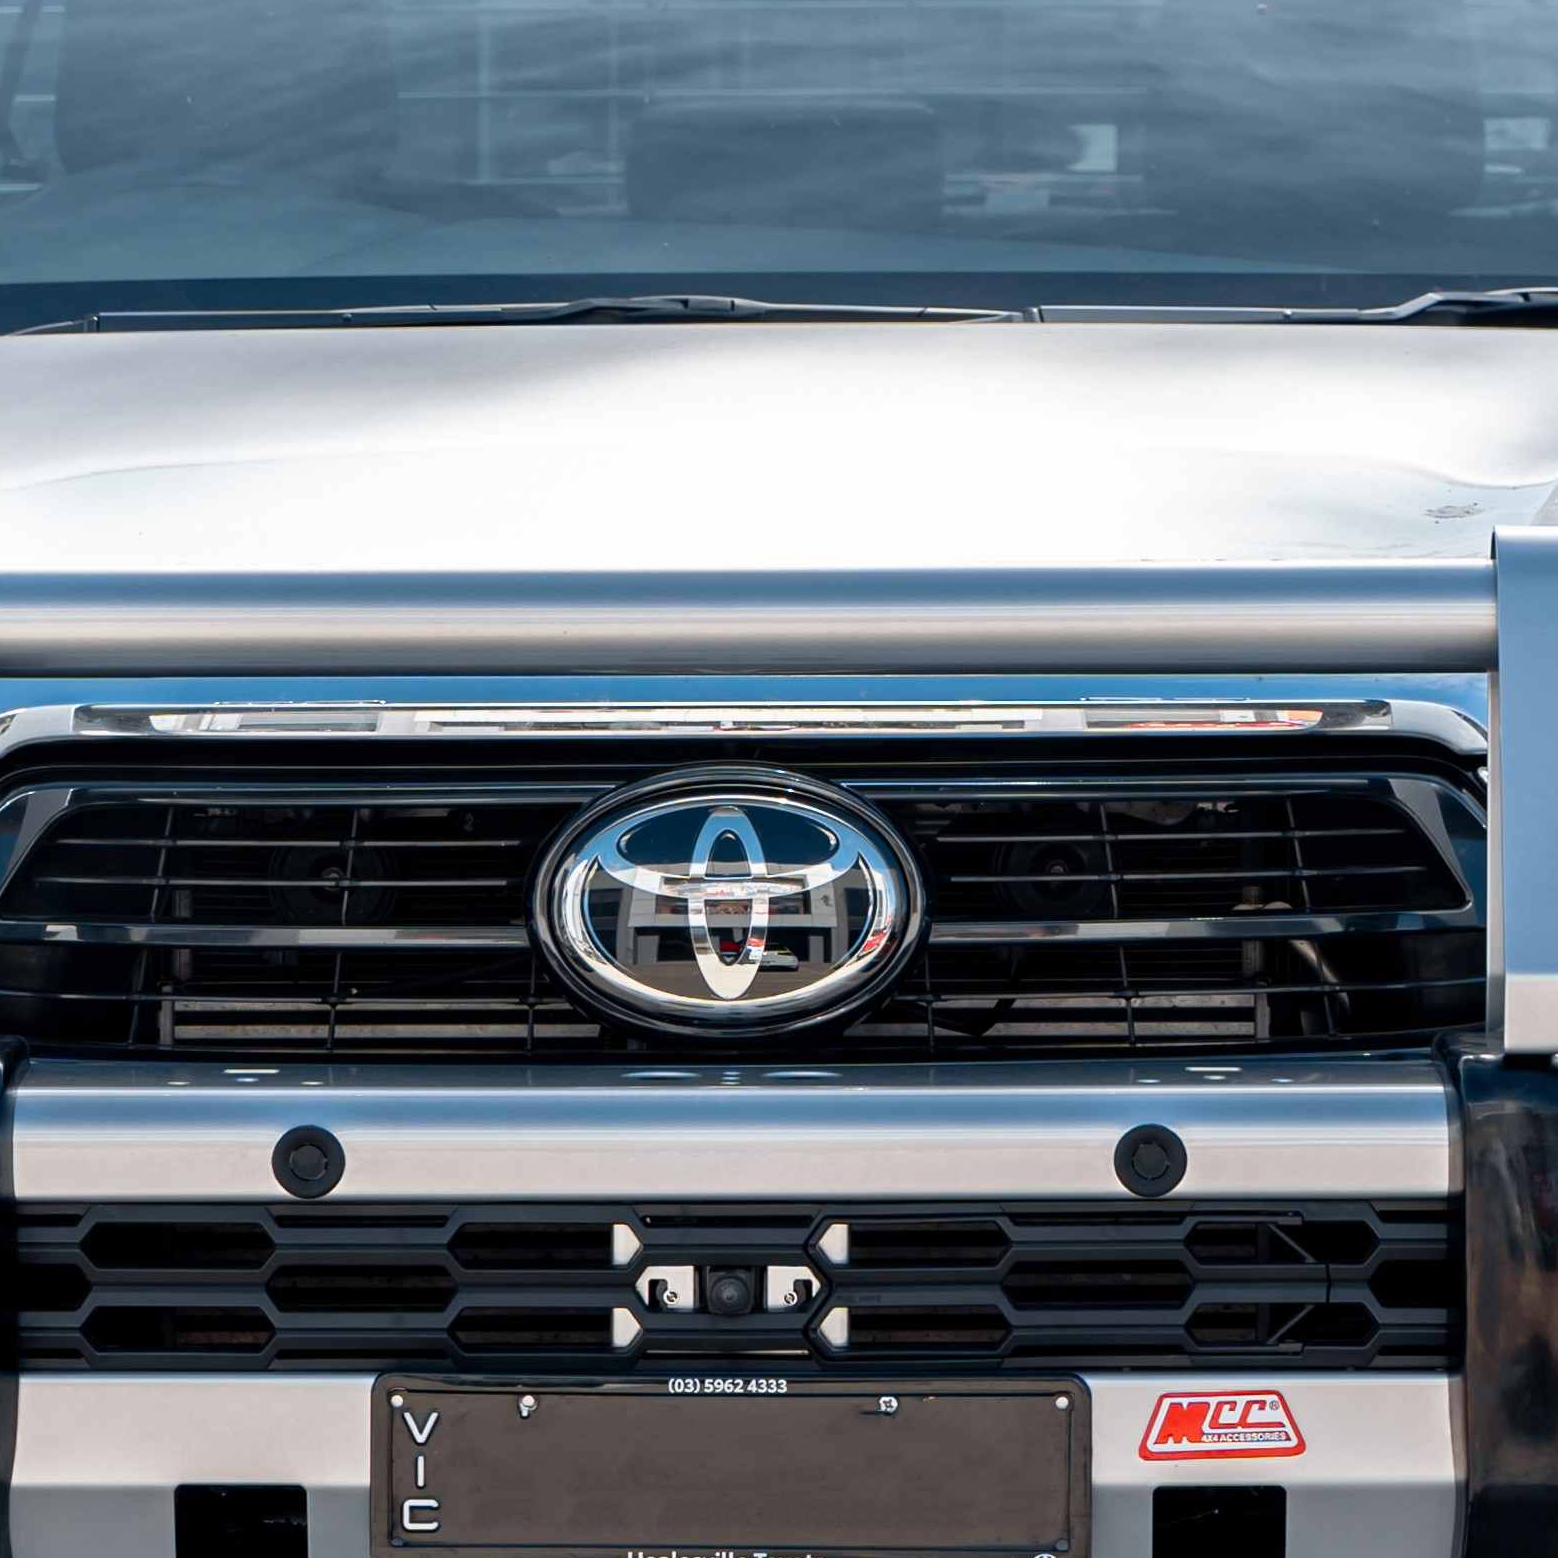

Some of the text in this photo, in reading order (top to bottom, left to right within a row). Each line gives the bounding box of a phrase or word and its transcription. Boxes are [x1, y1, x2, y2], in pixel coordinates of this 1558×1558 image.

[668, 1378, 788, 1393] (03) 5962 4333
[1220, 1431, 1287, 1442] ACCESSORIES
